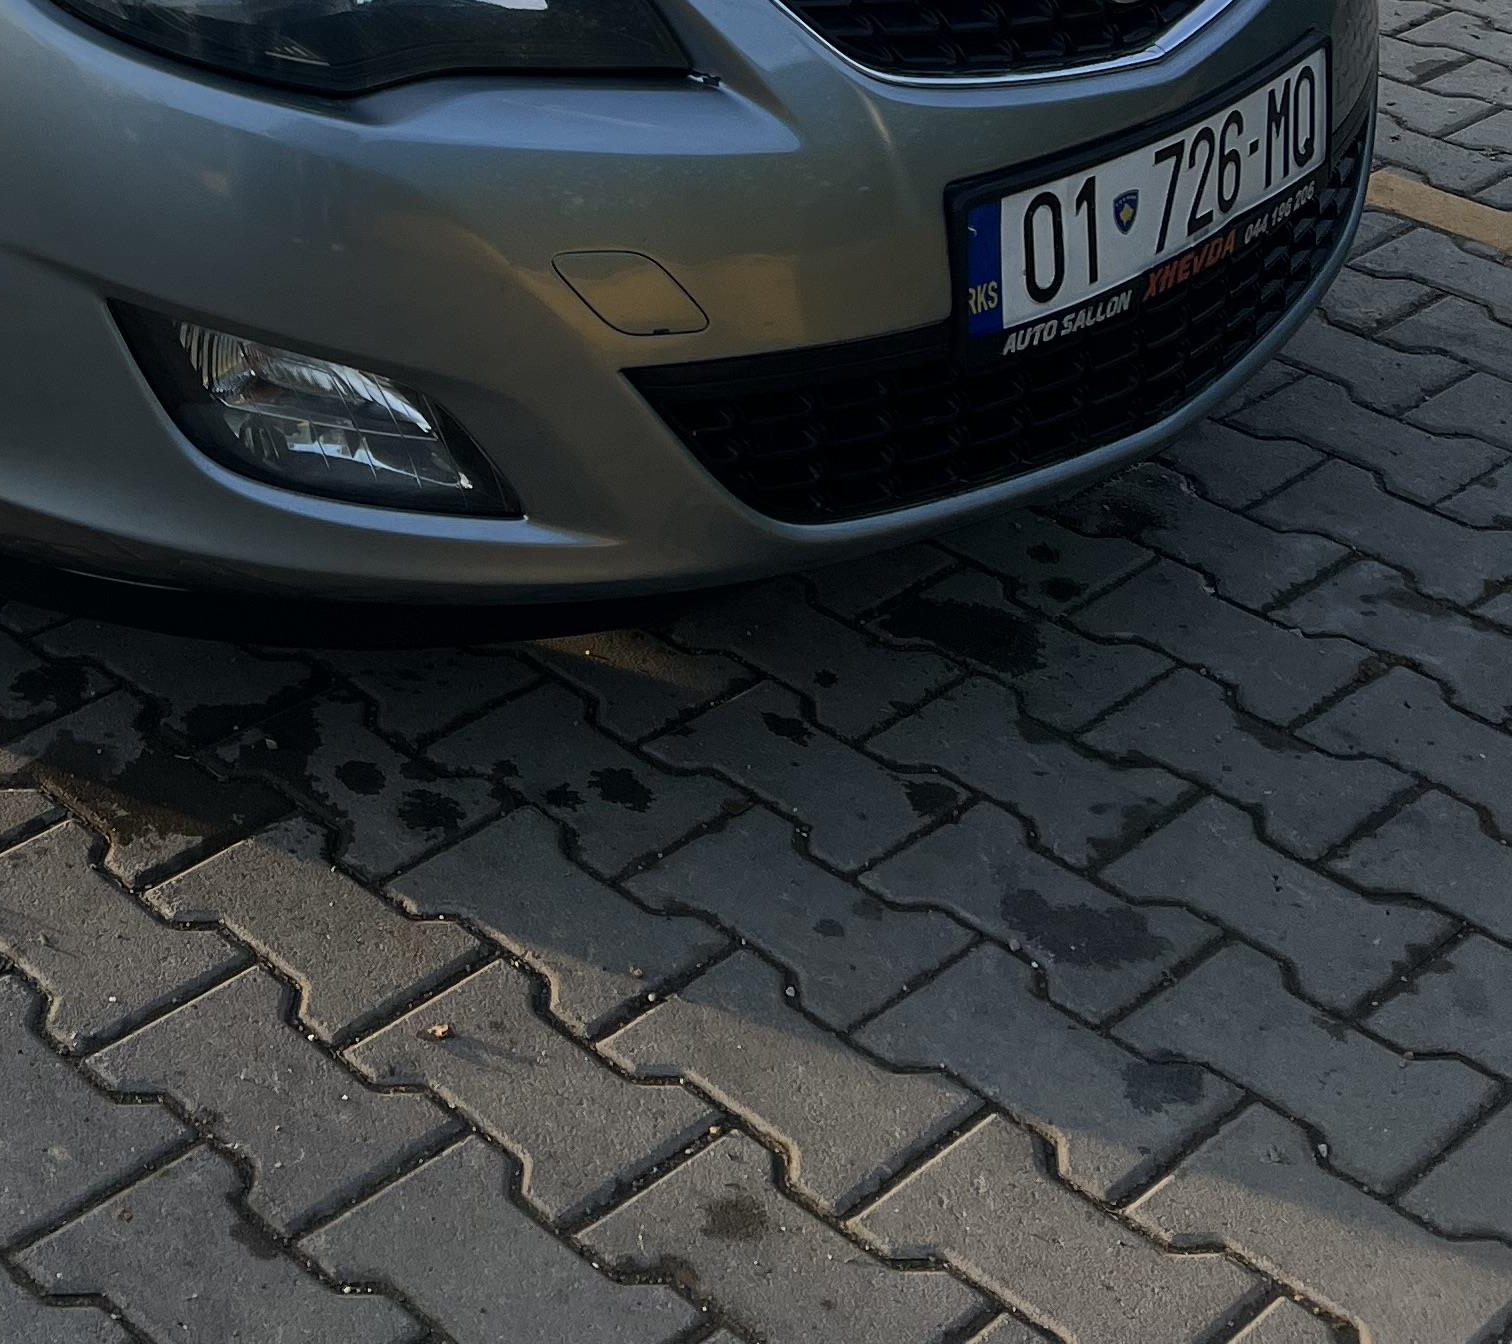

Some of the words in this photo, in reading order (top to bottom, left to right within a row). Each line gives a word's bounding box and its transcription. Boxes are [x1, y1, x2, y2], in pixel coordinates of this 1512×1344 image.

[1024, 175, 1098, 304] 01
[1153, 65, 1316, 256] 726-MQ
[1003, 319, 1058, 356] AUTO
[1060, 289, 1133, 336] SALLON
[1142, 228, 1236, 303] XHEVDA
